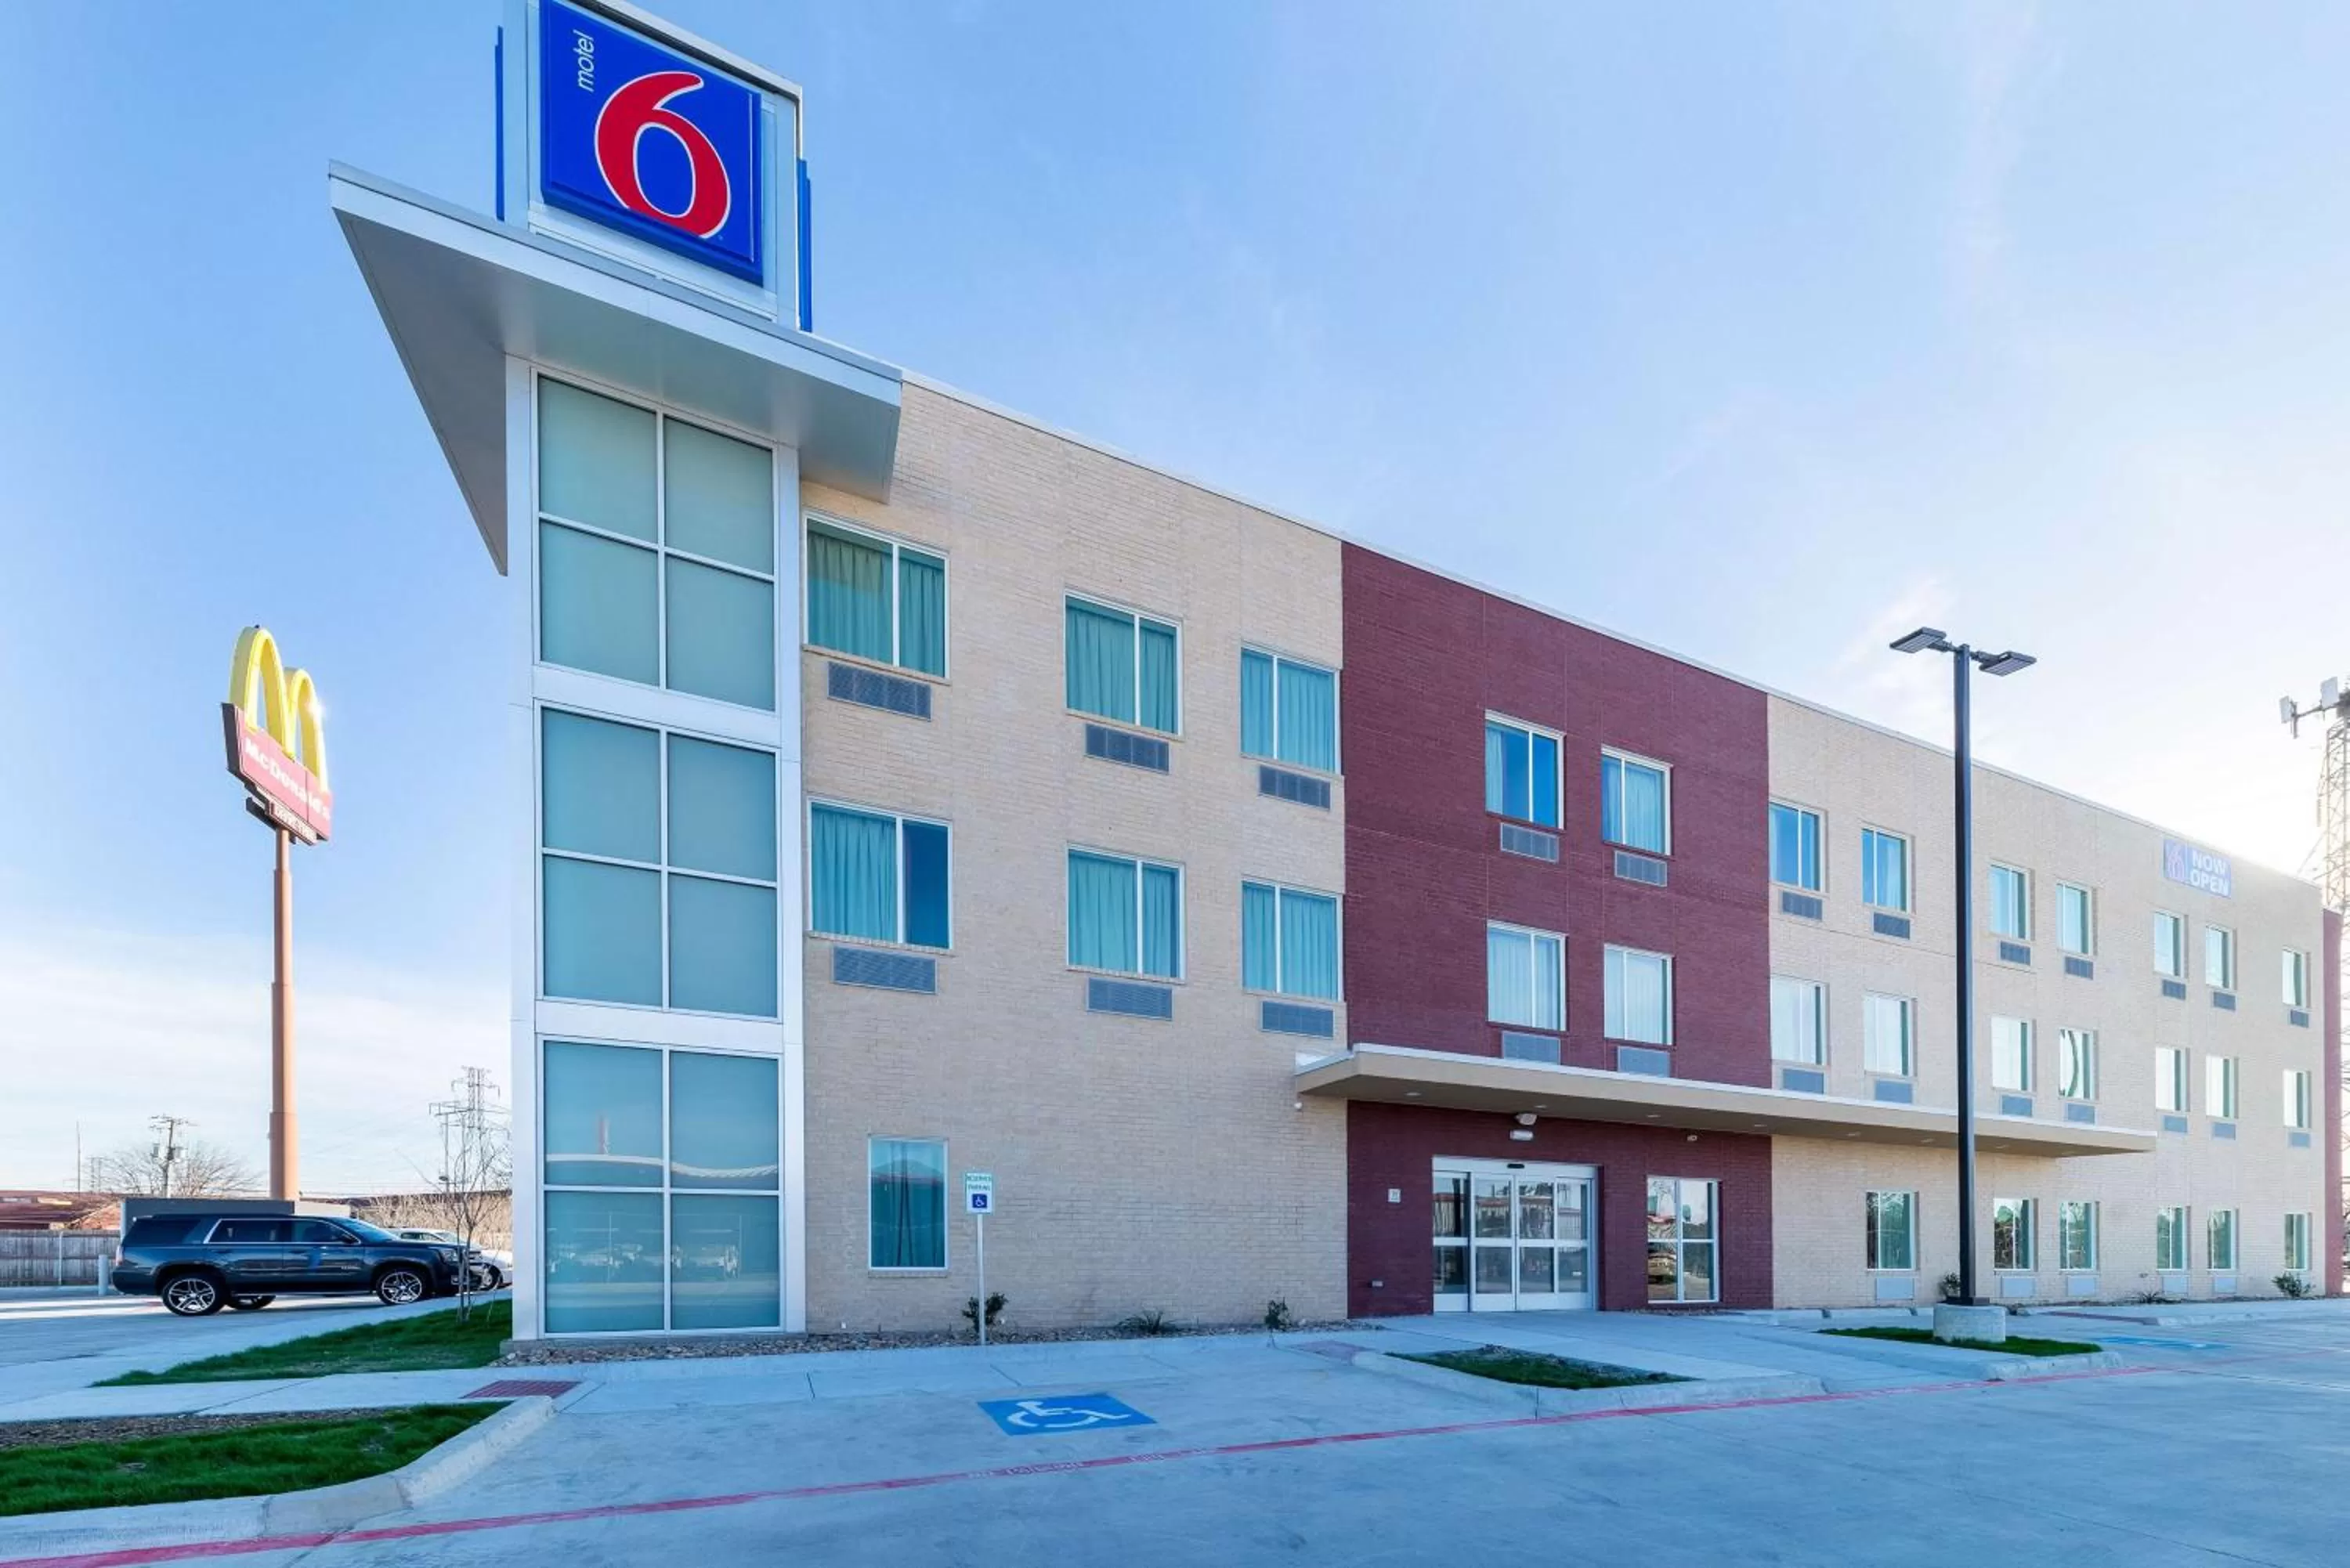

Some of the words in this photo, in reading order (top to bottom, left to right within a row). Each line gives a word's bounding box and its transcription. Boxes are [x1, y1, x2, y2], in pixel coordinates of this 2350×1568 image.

[573, 30, 595, 92] motel
[595, 70, 731, 238] 6
[244, 737, 331, 821] McDonalds
[2190, 869, 2229, 896] OPEN
[2193, 849, 2227, 876] NOW
